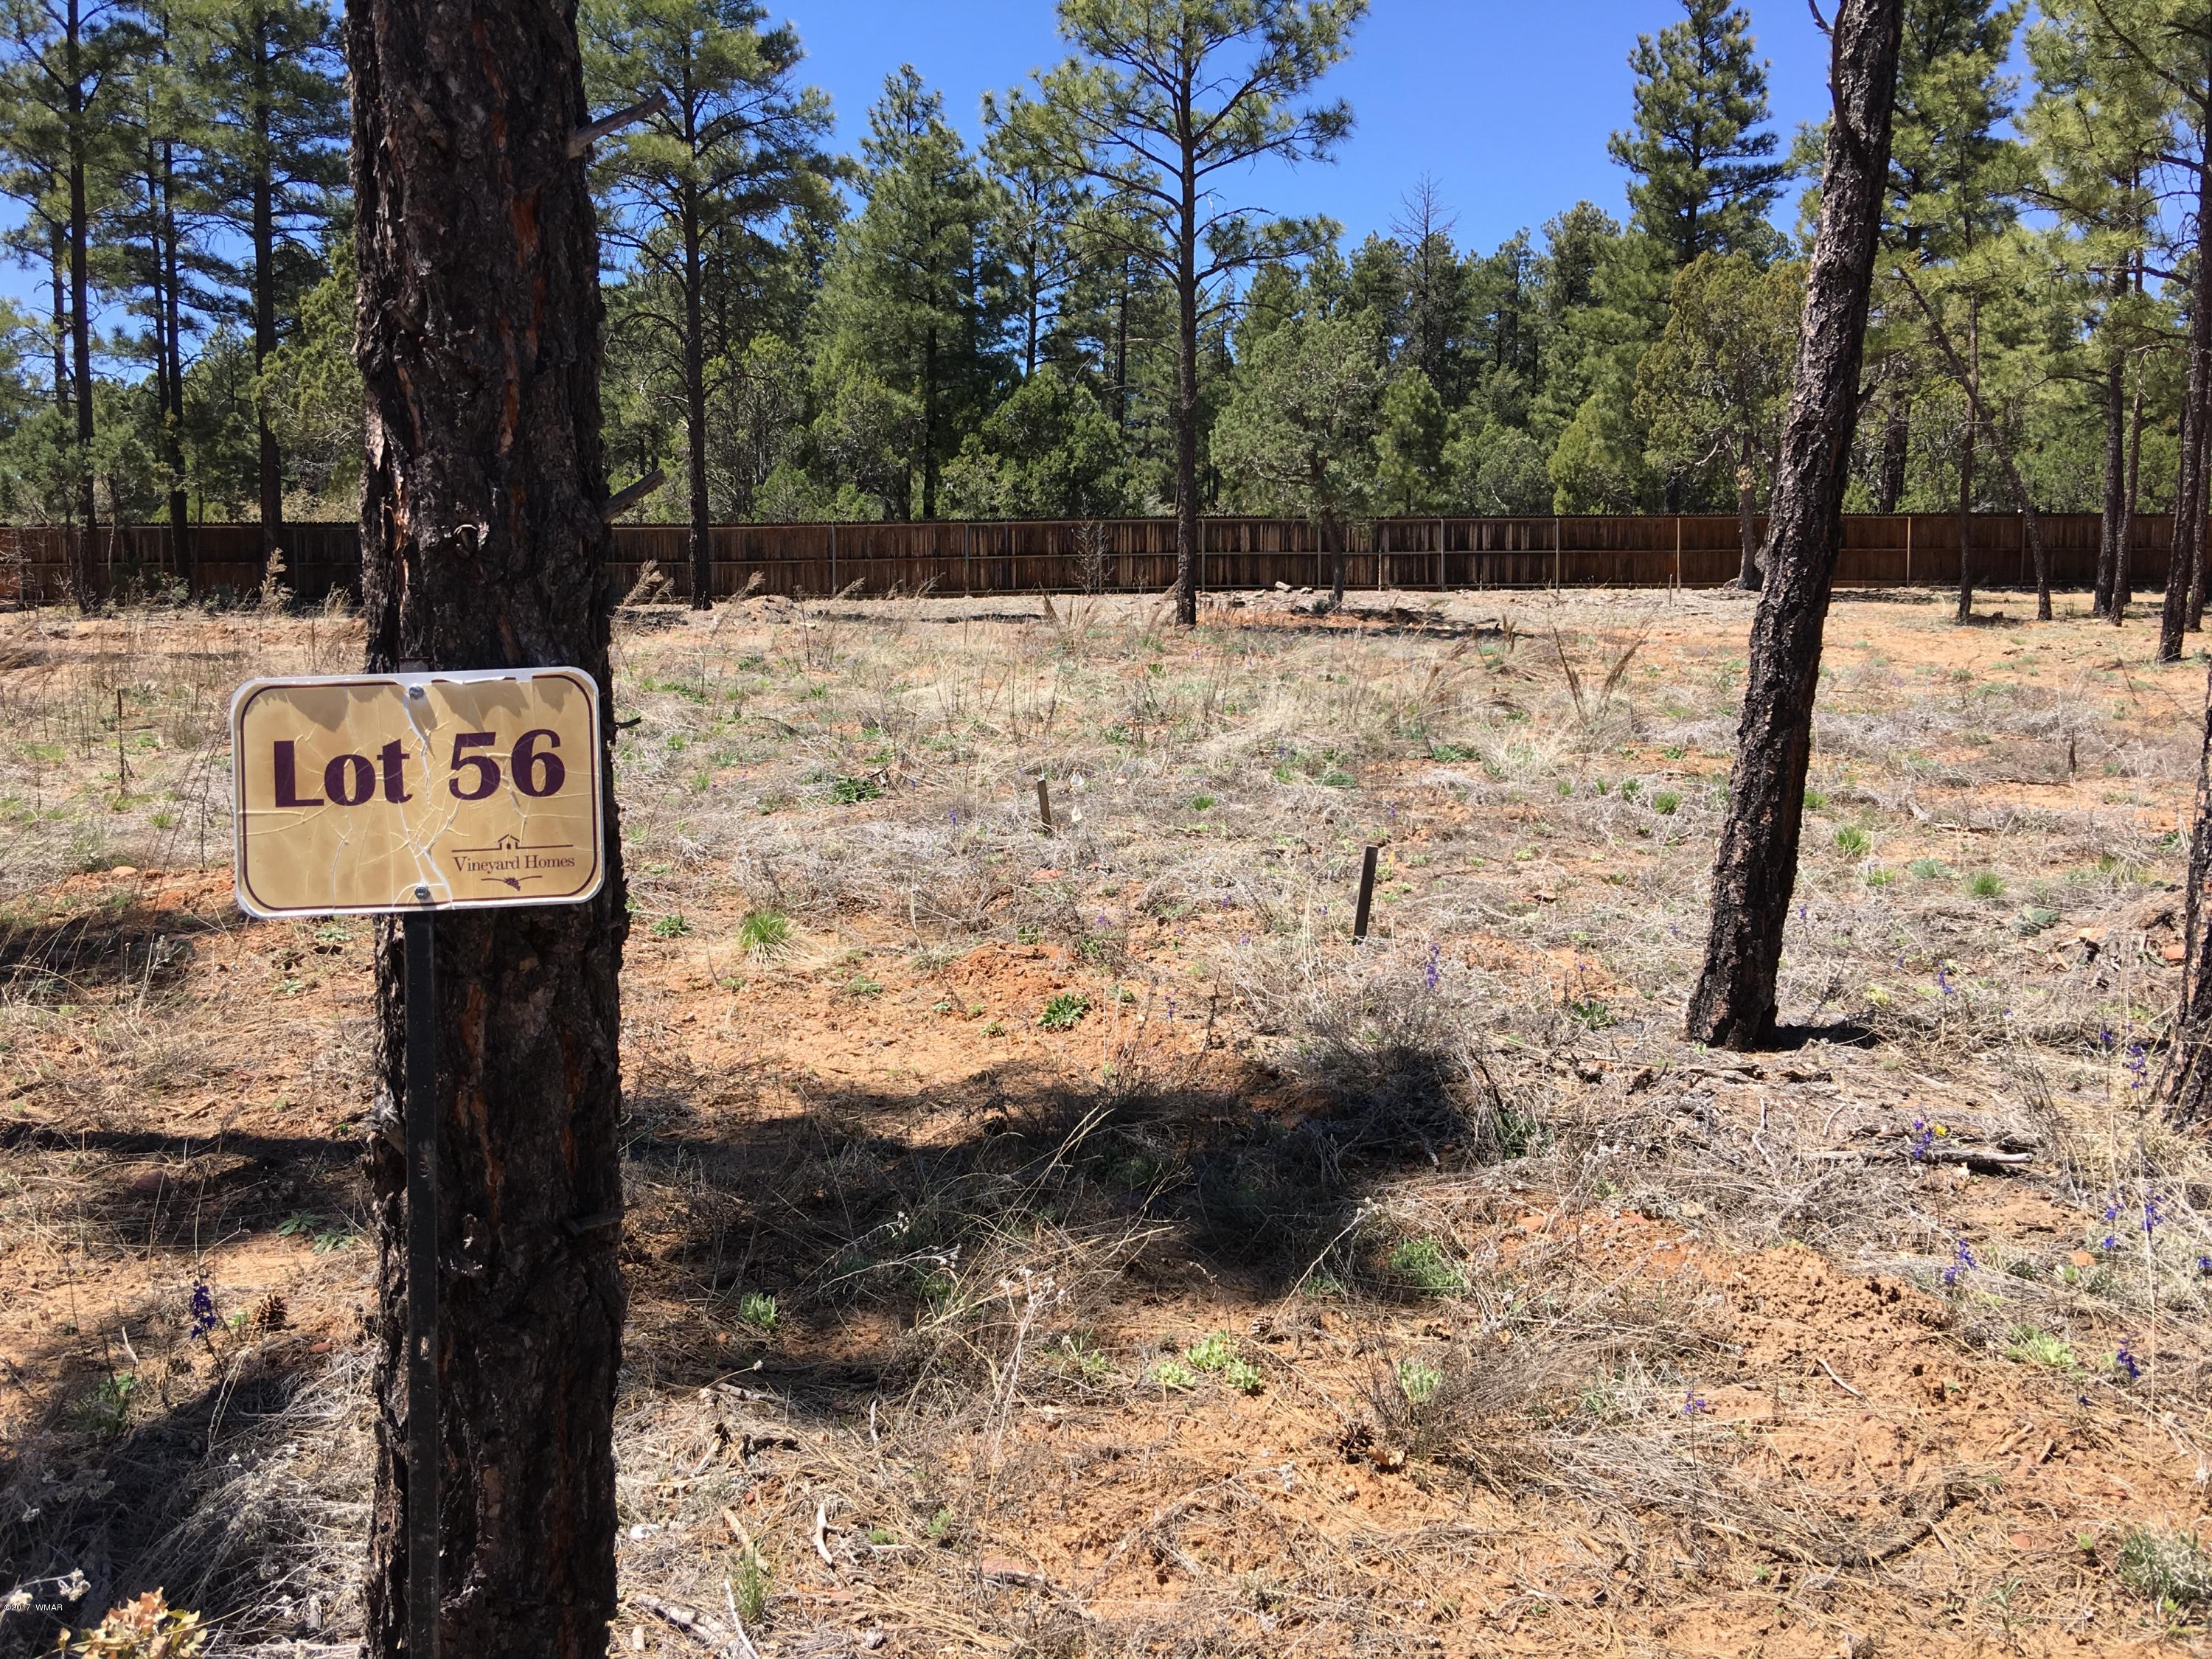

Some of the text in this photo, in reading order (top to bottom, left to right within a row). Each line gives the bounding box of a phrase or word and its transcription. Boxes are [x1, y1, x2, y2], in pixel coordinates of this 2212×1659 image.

[274, 728, 566, 808] Lot 56
[452, 855, 575, 874] Vineyard Homes
